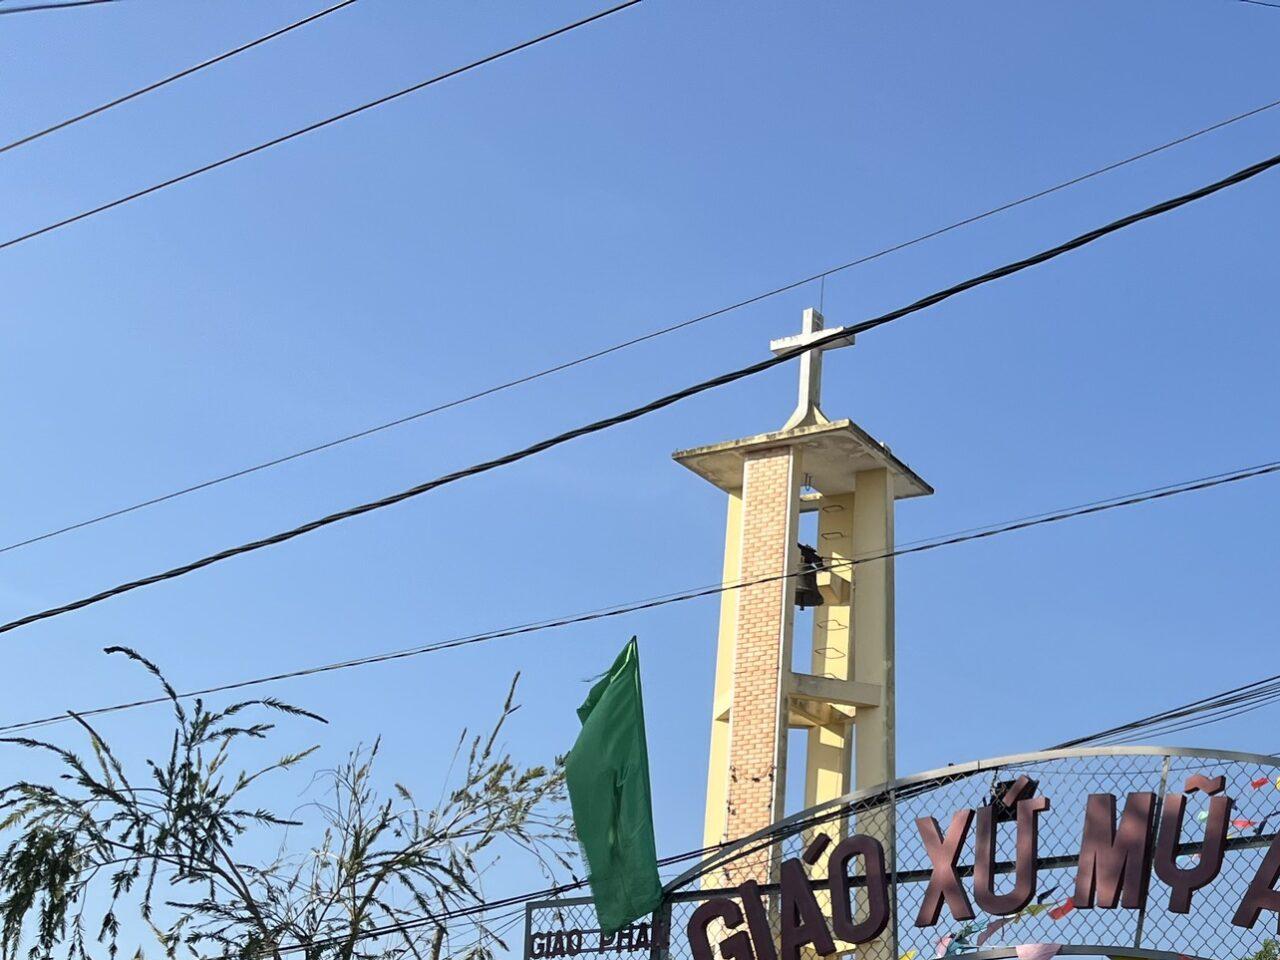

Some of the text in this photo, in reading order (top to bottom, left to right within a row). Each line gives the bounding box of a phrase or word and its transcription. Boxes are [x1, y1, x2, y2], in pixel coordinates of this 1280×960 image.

[915, 774, 1051, 929] XỨ
[1073, 774, 1237, 915] MỸ
[529, 928, 583, 960] GIAO
